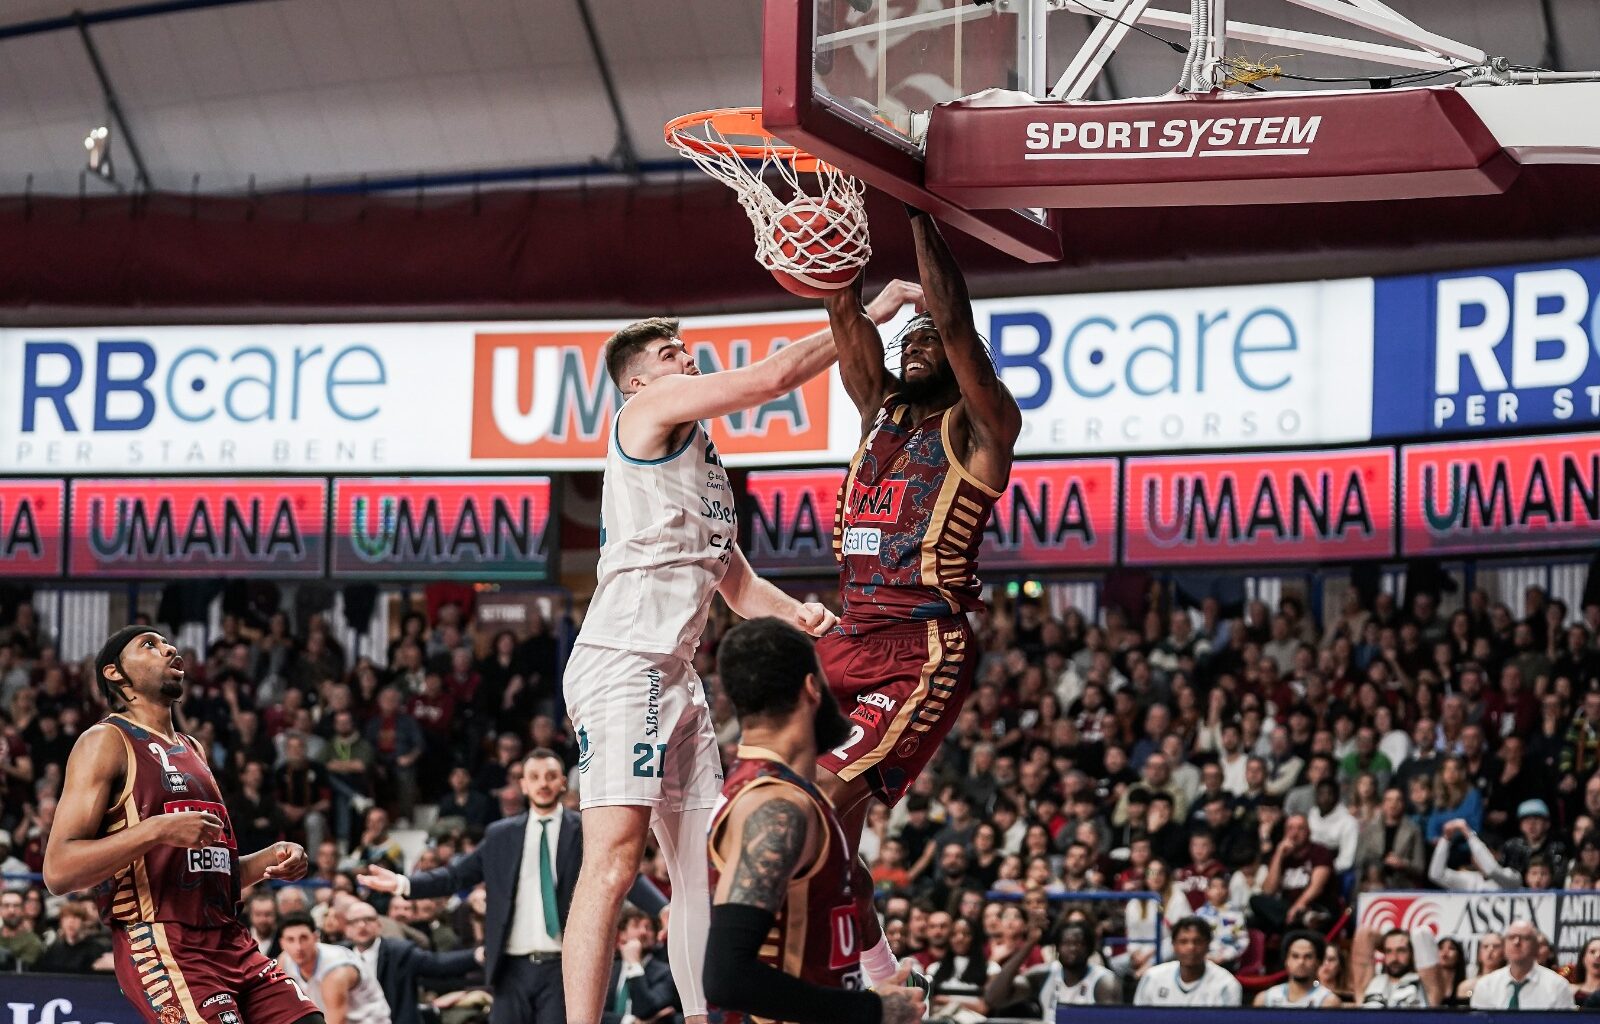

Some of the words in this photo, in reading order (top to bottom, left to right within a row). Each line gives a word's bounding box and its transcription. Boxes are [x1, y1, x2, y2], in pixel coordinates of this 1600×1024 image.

[1025, 120, 1155, 150] SPORT
[1158, 115, 1322, 157] SYSTEM
[989, 306, 1298, 410] Bcare
[1435, 268, 1600, 395] RB
[21, 340, 388, 432] RBcare
[492, 337, 810, 444] UMNA
[1434, 392, 1519, 429] PER
[16, 440, 93, 465] PER
[128, 439, 237, 464] STAR
[272, 438, 388, 463] BENE
[90, 496, 304, 560] UMANA
[1144, 469, 1375, 548] UMANA
[148, 742, 178, 773] 2
[633, 742, 667, 778] 21
[831, 725, 865, 761] 2
